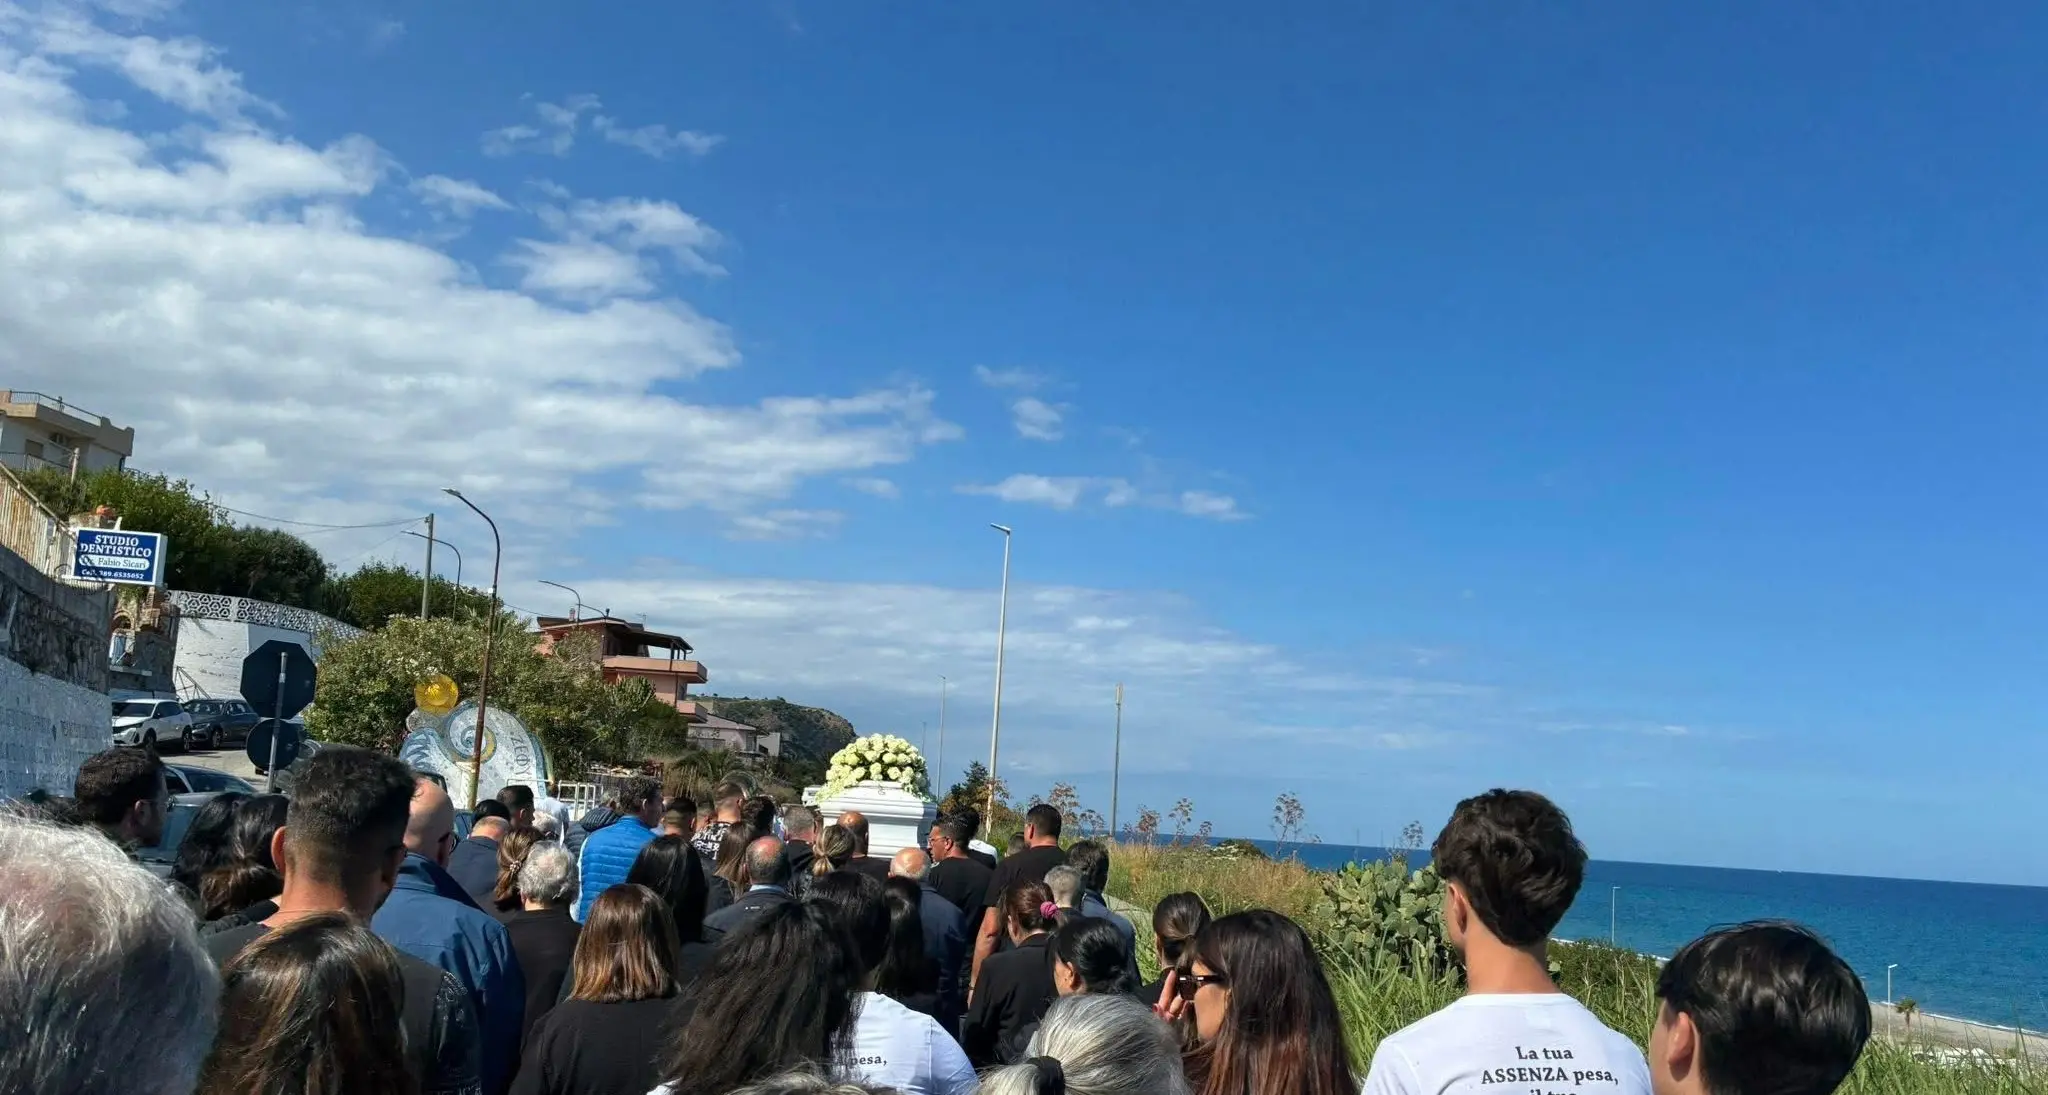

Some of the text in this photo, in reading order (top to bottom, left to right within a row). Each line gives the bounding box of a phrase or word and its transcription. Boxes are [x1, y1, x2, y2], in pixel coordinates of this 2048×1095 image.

[94, 534, 139, 547] STUDIO
[80, 543, 152, 558] DENTISTICO
[98, 557, 121, 567] Fabio
[122, 559, 147, 569] Sicari
[511, 734, 532, 777] ΖΕΦΥ
[1515, 1046, 1574, 1060] La tua
[851, 1055, 887, 1069] pesa,
[1481, 1067, 1619, 1086] ASSENZA pesa,
